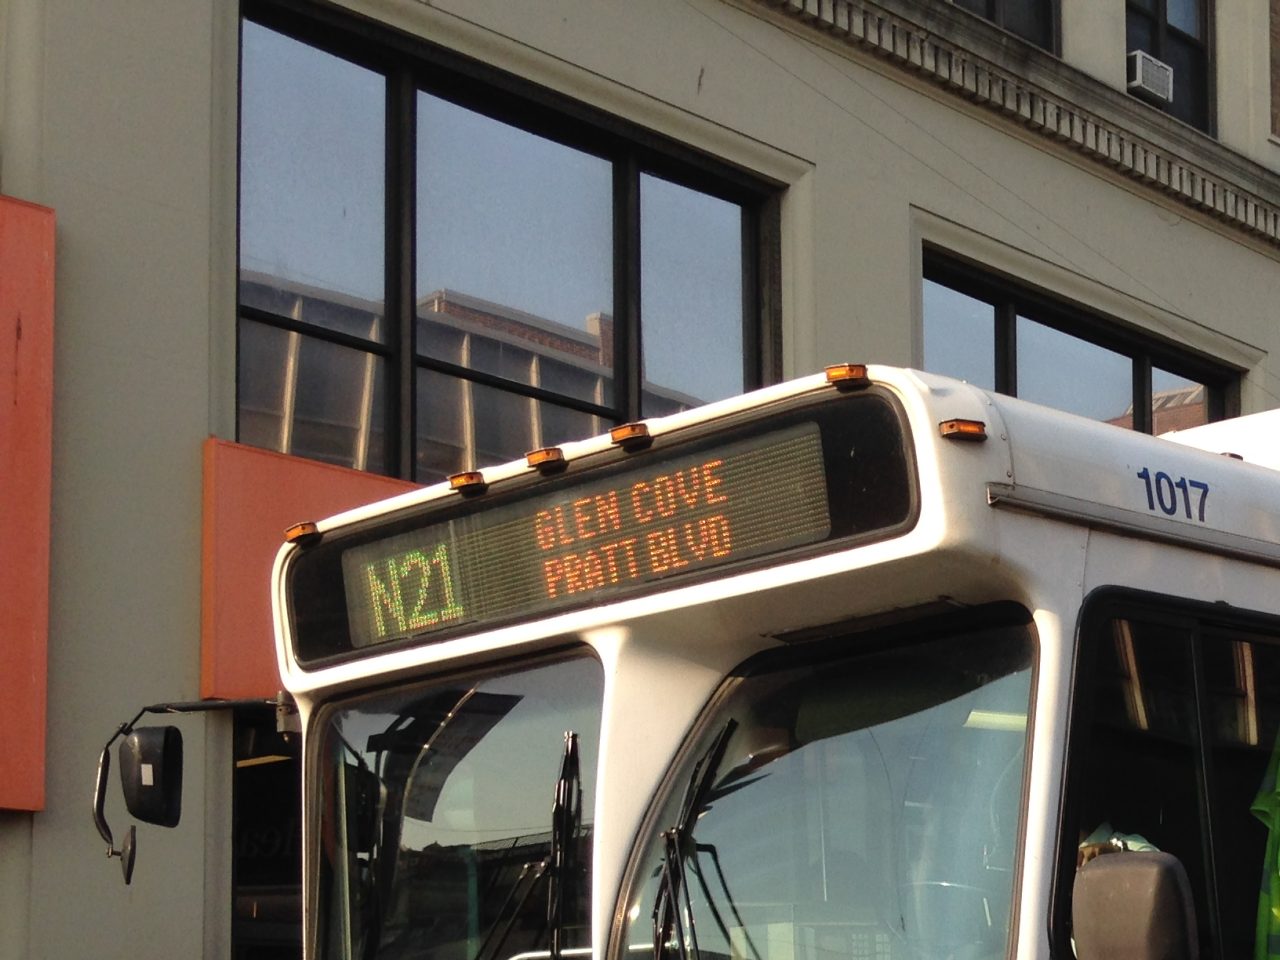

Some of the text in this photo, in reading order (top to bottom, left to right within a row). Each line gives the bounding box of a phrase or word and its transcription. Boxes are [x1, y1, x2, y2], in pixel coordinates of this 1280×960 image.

[535, 459, 729, 551] GLEN COVE
[1136, 467, 1210, 522] 1017
[366, 543, 464, 638] N21
[542, 514, 732, 600] PRATT BLVD
